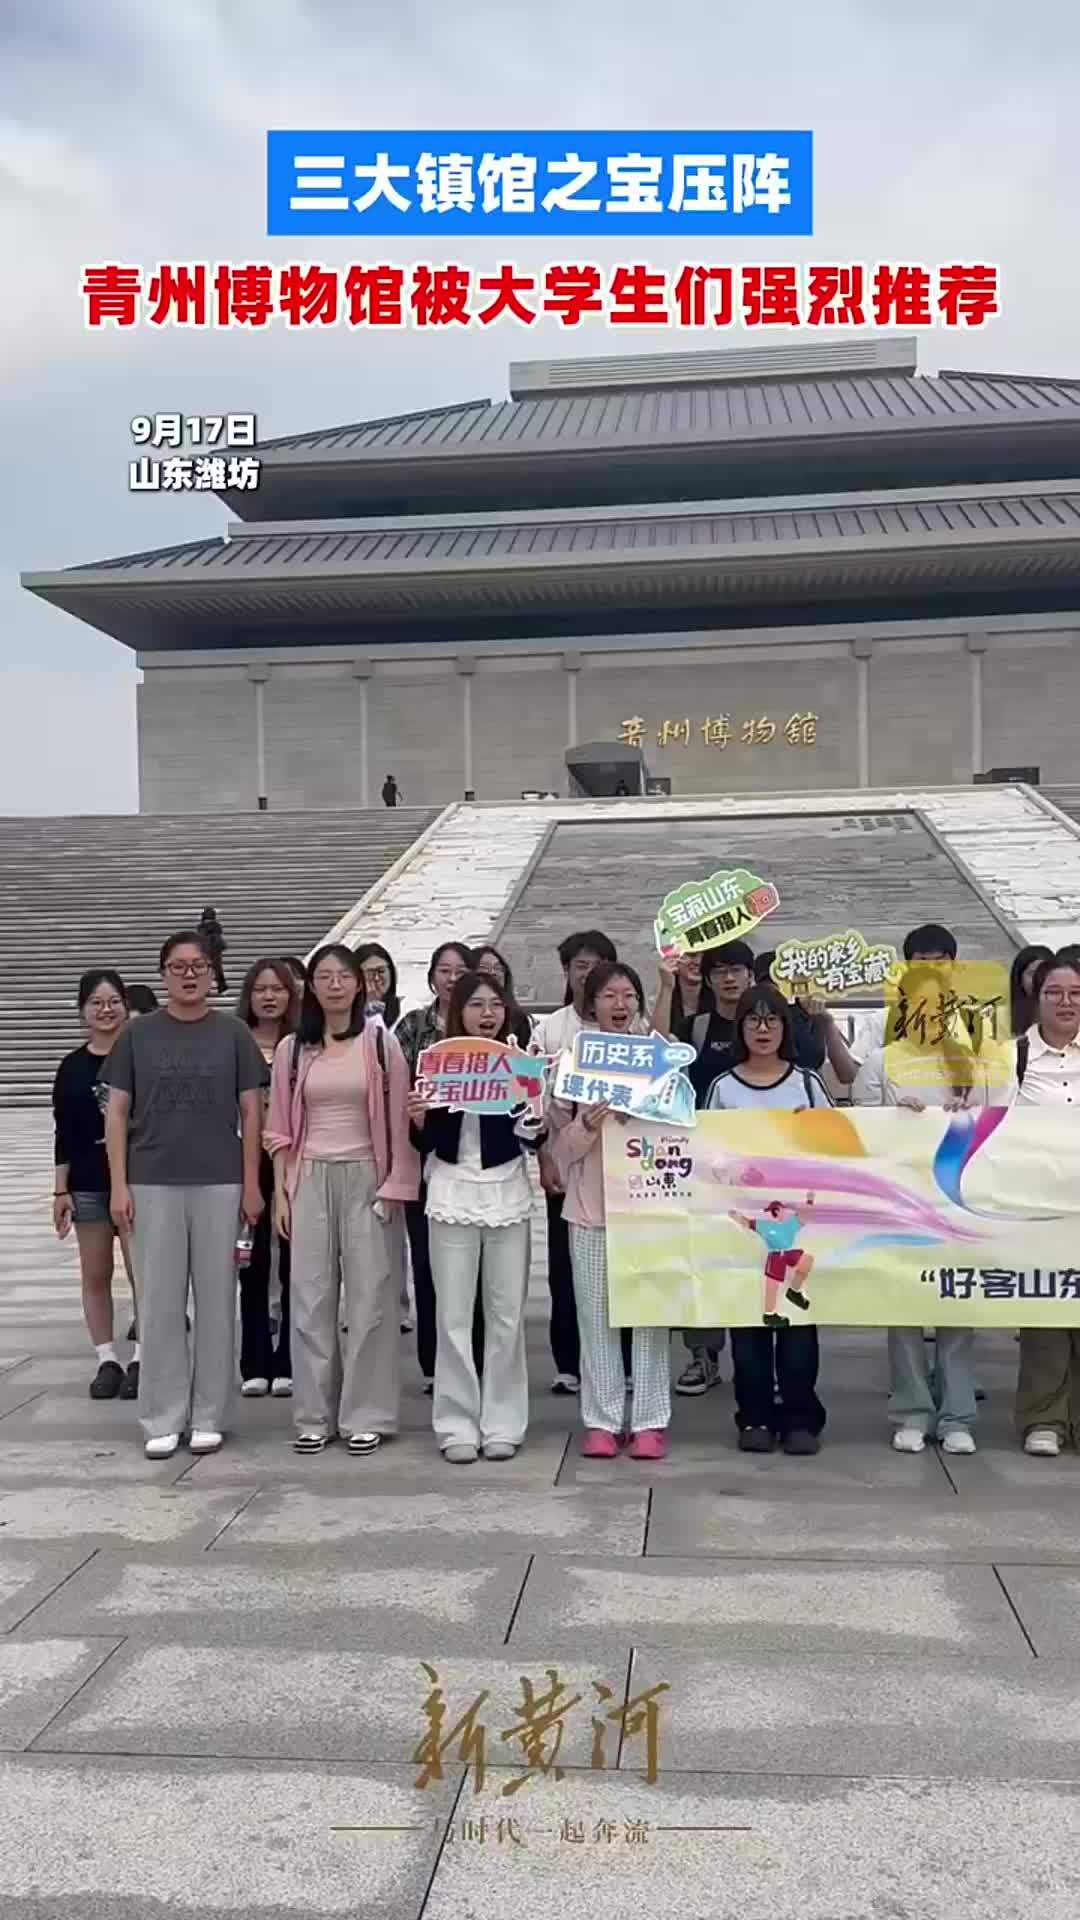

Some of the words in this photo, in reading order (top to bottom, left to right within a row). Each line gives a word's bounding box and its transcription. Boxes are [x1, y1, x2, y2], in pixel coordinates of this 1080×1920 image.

[780, 937, 861, 979] 我的家乡
[816, 954, 895, 991] 有宝藏
[582, 1040, 656, 1068] 历史系
[562, 1073, 634, 1107] 课代表
